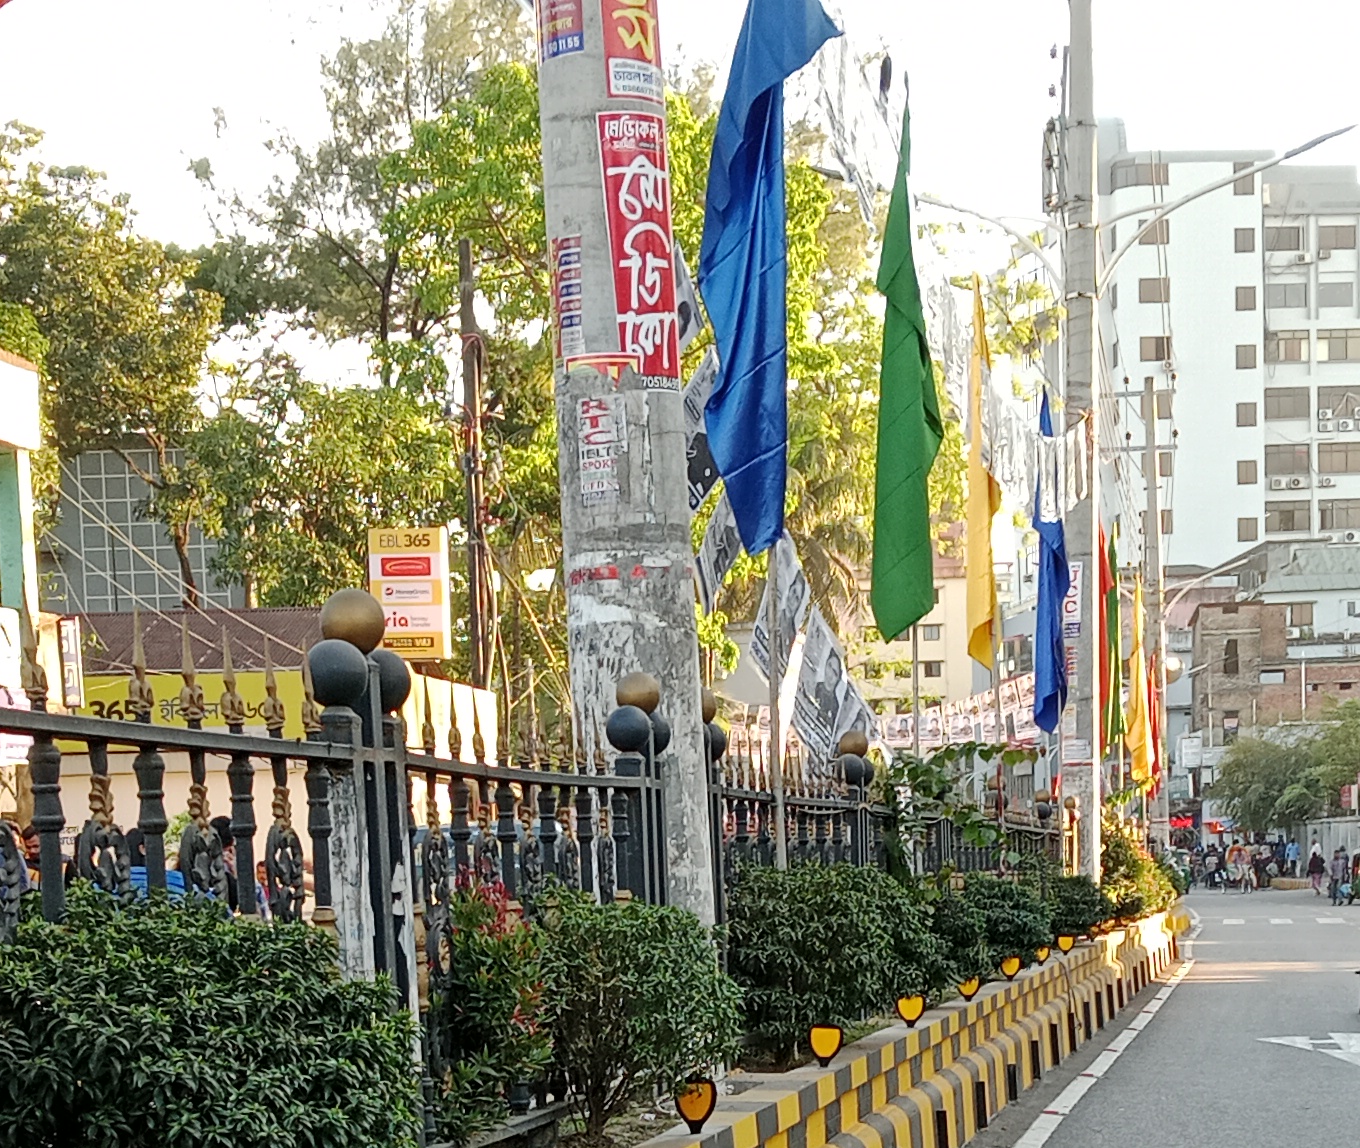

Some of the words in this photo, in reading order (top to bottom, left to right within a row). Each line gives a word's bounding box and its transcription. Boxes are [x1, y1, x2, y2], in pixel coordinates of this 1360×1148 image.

[379, 534, 402, 548] EBL
[402, 533, 431, 548] 365
[384, 611, 409, 628] ria
